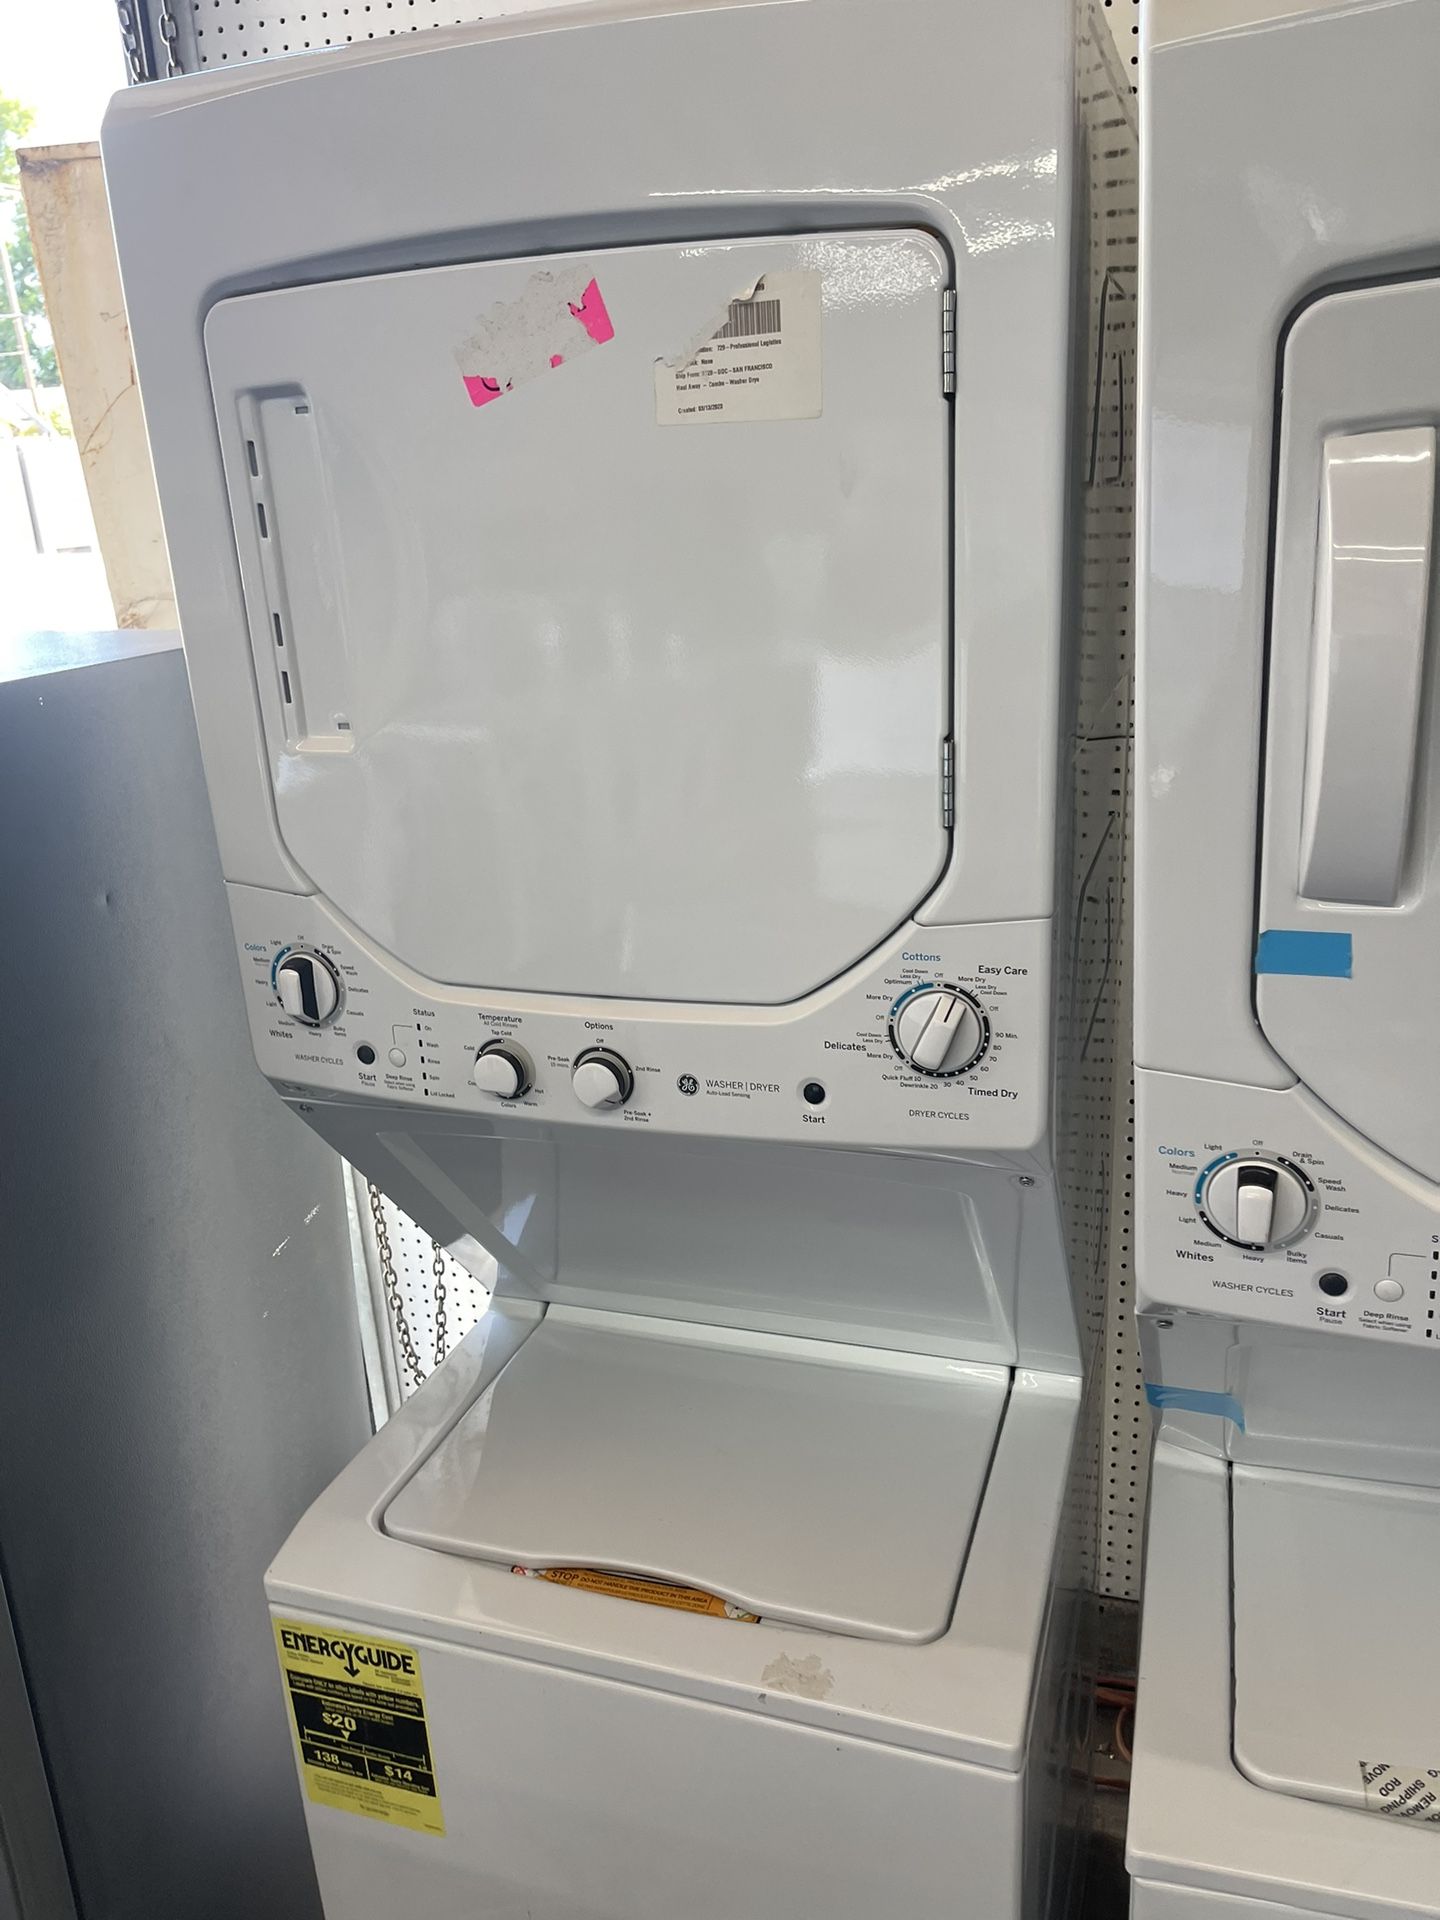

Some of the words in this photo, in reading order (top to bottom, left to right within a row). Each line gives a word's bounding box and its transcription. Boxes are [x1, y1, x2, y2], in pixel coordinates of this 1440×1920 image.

[745, 363, 772, 371] FRANCISCO
[245, 943, 267, 951] Colors
[902, 952, 941, 962] Cottons
[978, 965, 1001, 976] Easy
[1004, 966, 1028, 976] Care
[413, 1009, 435, 1017] Status
[478, 1013, 522, 1023] Temperature
[584, 1021, 614, 1030] Options
[269, 1030, 293, 1038] Whites
[824, 1041, 867, 1052] Delicates
[295, 1054, 320, 1062] WASHER
[322, 1057, 343, 1065] CYCLES
[358, 1072, 377, 1081] Start
[706, 1080, 743, 1090] WASHER
[750, 1083, 780, 1092] DRYER
[968, 1087, 998, 1097] Timed
[1000, 1089, 1019, 1099] Dry
[802, 1114, 825, 1124] Start
[909, 1110, 936, 1119] DRYER
[938, 1112, 970, 1121] CYCLES
[1158, 1146, 1195, 1158] Colors
[1204, 1143, 1222, 1152] Light
[1292, 1151, 1313, 1159] Drain
[1169, 1163, 1198, 1171] Medium
[1307, 1158, 1325, 1166] Spin
[1318, 1177, 1342, 1186] Speed
[1325, 1184, 1346, 1192] Wash
[1166, 1189, 1188, 1198] Heavy
[1325, 1205, 1360, 1214] Delicates
[1179, 1216, 1197, 1224] Light
[1315, 1232, 1344, 1241] Casuals
[1193, 1240, 1222, 1248] Medium
[1176, 1249, 1214, 1263] Whites
[1242, 1254, 1265, 1263] Heavy
[1287, 1250, 1307, 1259] Bulky
[1212, 1279, 1253, 1294] WASHER
[1256, 1285, 1294, 1298] CYCLES
[1316, 1307, 1347, 1319] Start
[1363, 1310, 1384, 1319] Deep
[1385, 1312, 1409, 1322] Rinse
[551, 1570, 579, 1582] STOP
[641, 1587, 669, 1598] PRODUCT
[280, 1629, 416, 1676] ENERGYGUIDE
[322, 1712, 357, 1731] $20
[314, 1750, 339, 1765] 138
[384, 1765, 413, 1781] $14
[1379, 1777, 1402, 1796] ROD
[1380, 1779, 1425, 1814] SHIPPING
[1400, 1792, 1437, 1817] REMOV
